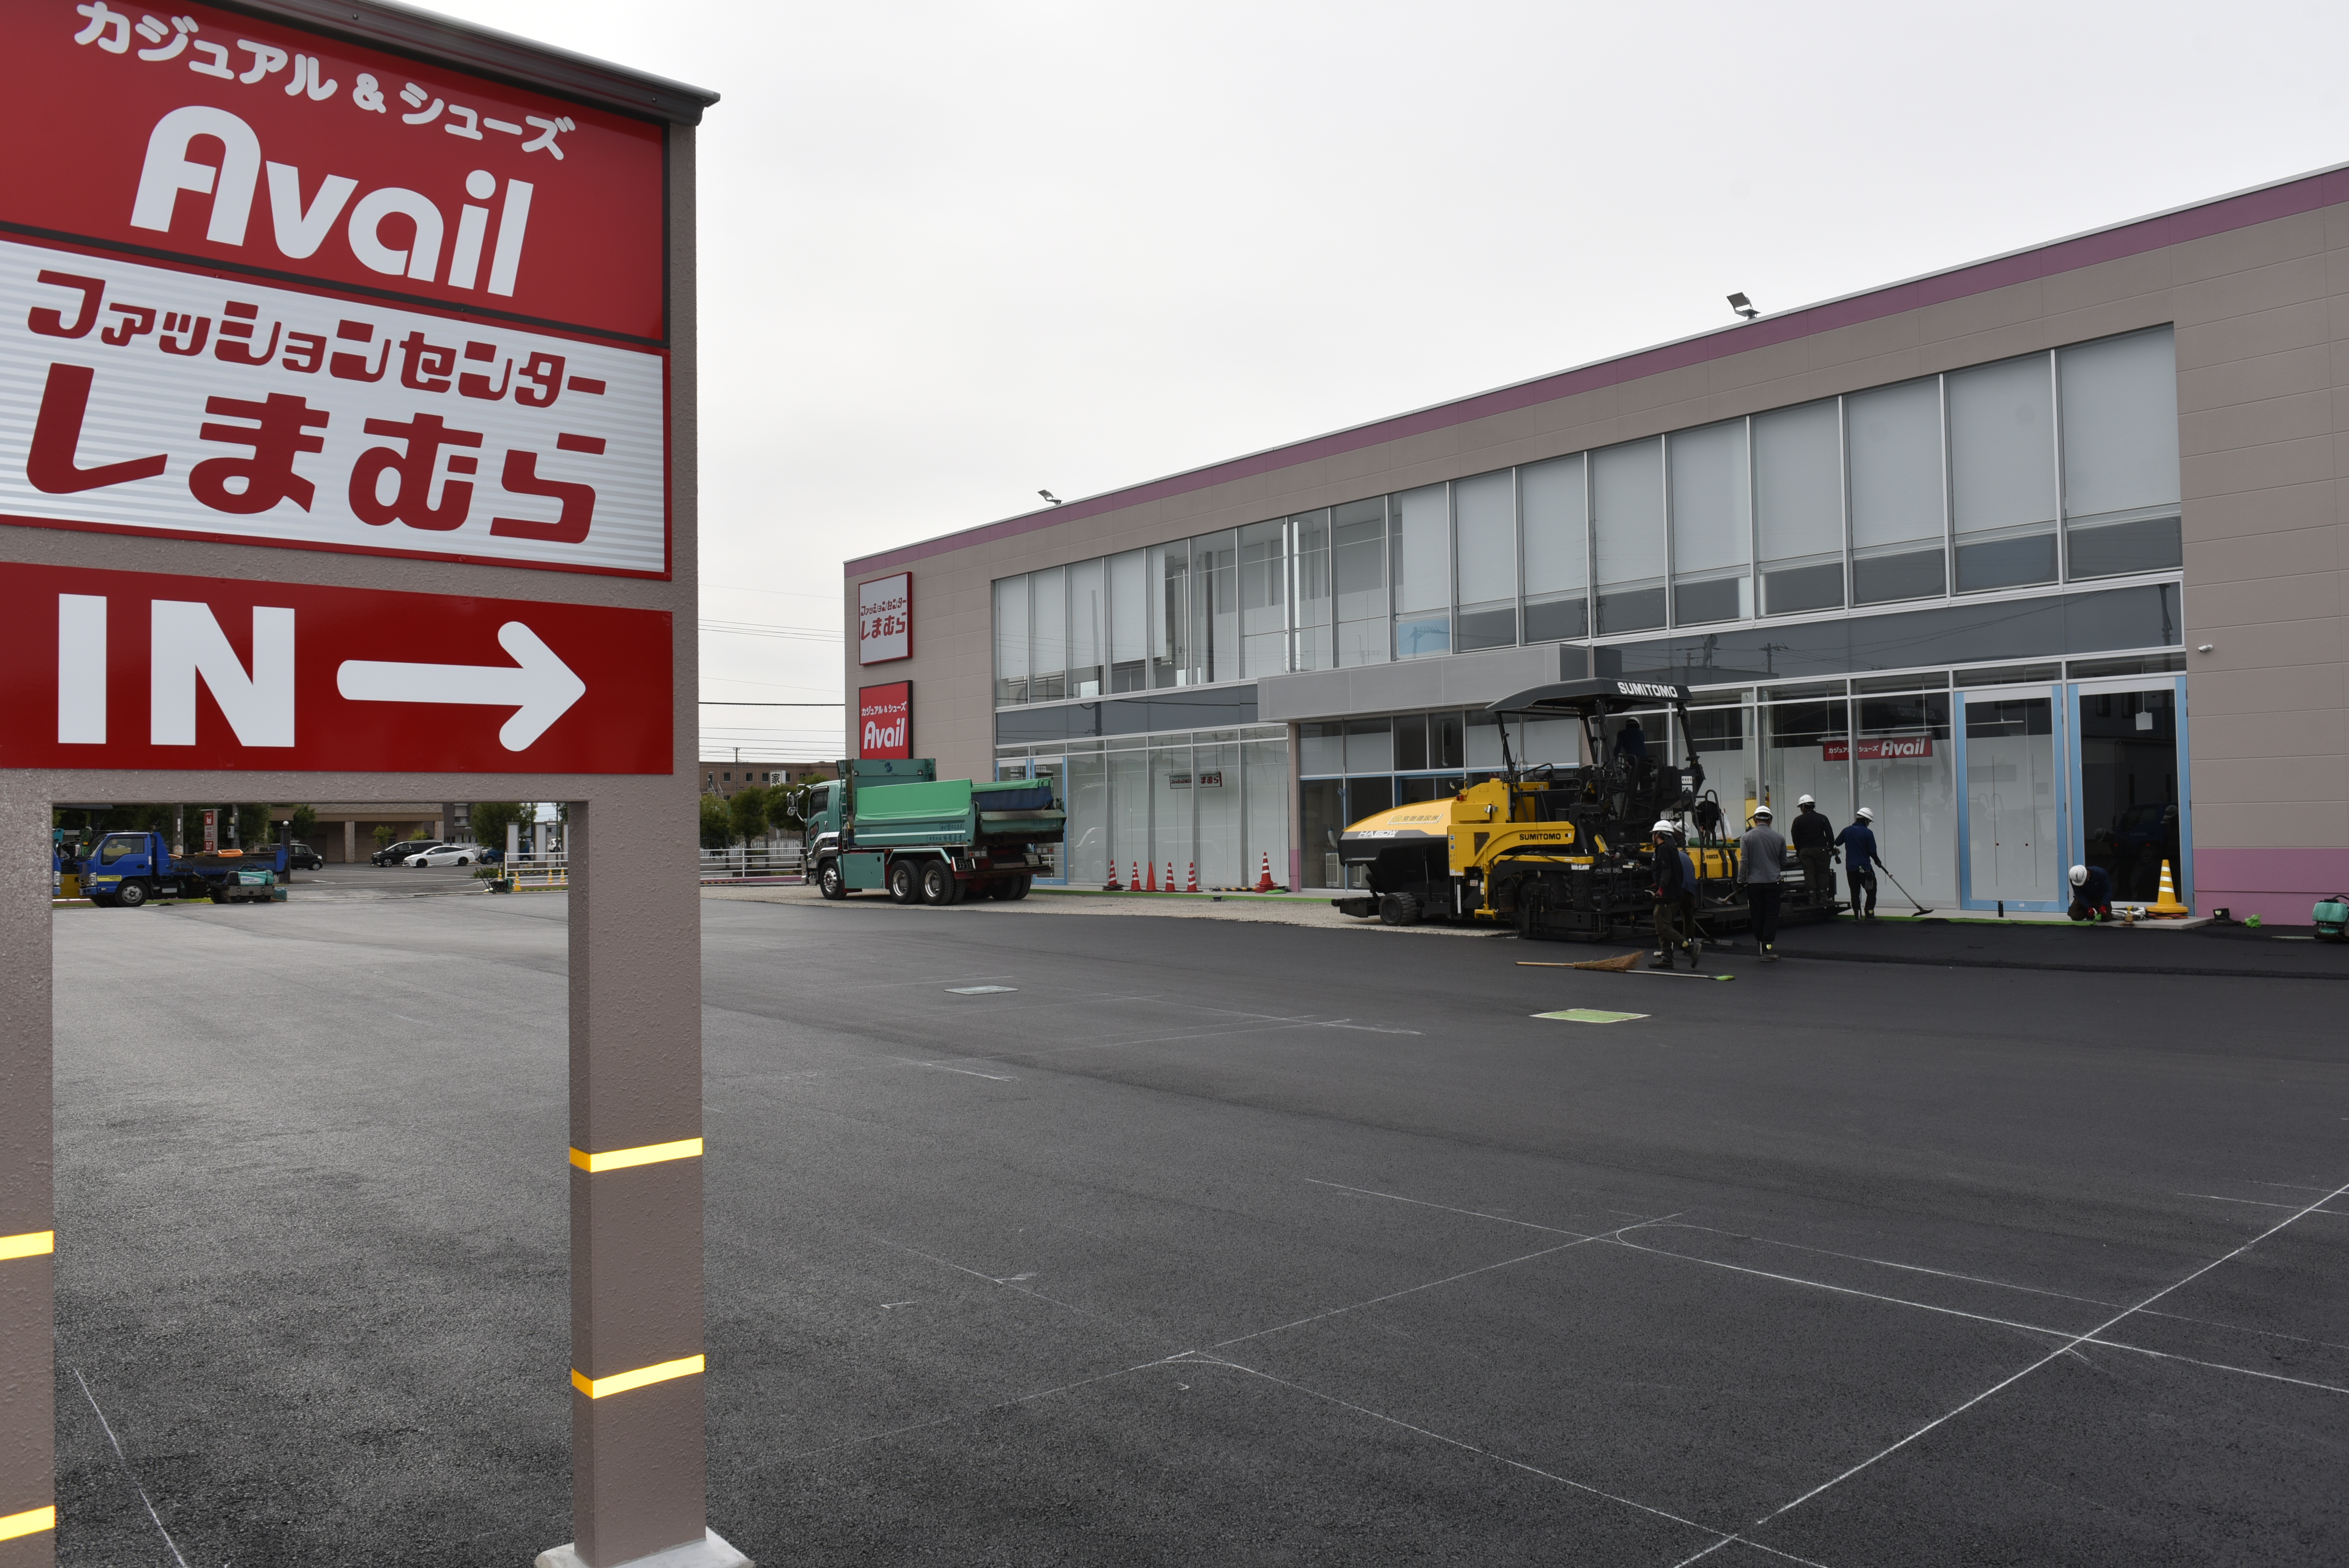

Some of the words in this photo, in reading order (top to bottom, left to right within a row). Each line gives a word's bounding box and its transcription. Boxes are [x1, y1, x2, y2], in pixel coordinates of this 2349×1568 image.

[74, 1, 338, 102] カジュアル
[353, 73, 387, 113] &
[399, 82, 576, 160] シューズ
[130, 105, 534, 298] Avail
[27, 269, 606, 408] ファッションセンター
[26, 362, 606, 544] しまむら
[861, 597, 906, 616] ファッションセンター
[861, 612, 906, 641] しまむら
[58, 593, 295, 747] IN
[1617, 682, 1678, 698] SUMITOMO
[861, 705, 883, 716] カジュアル
[888, 701, 907, 713] シューズ
[864, 718, 905, 749] Avail
[1881, 738, 1925, 756] Avail
[772, 773, 780, 784] 家
